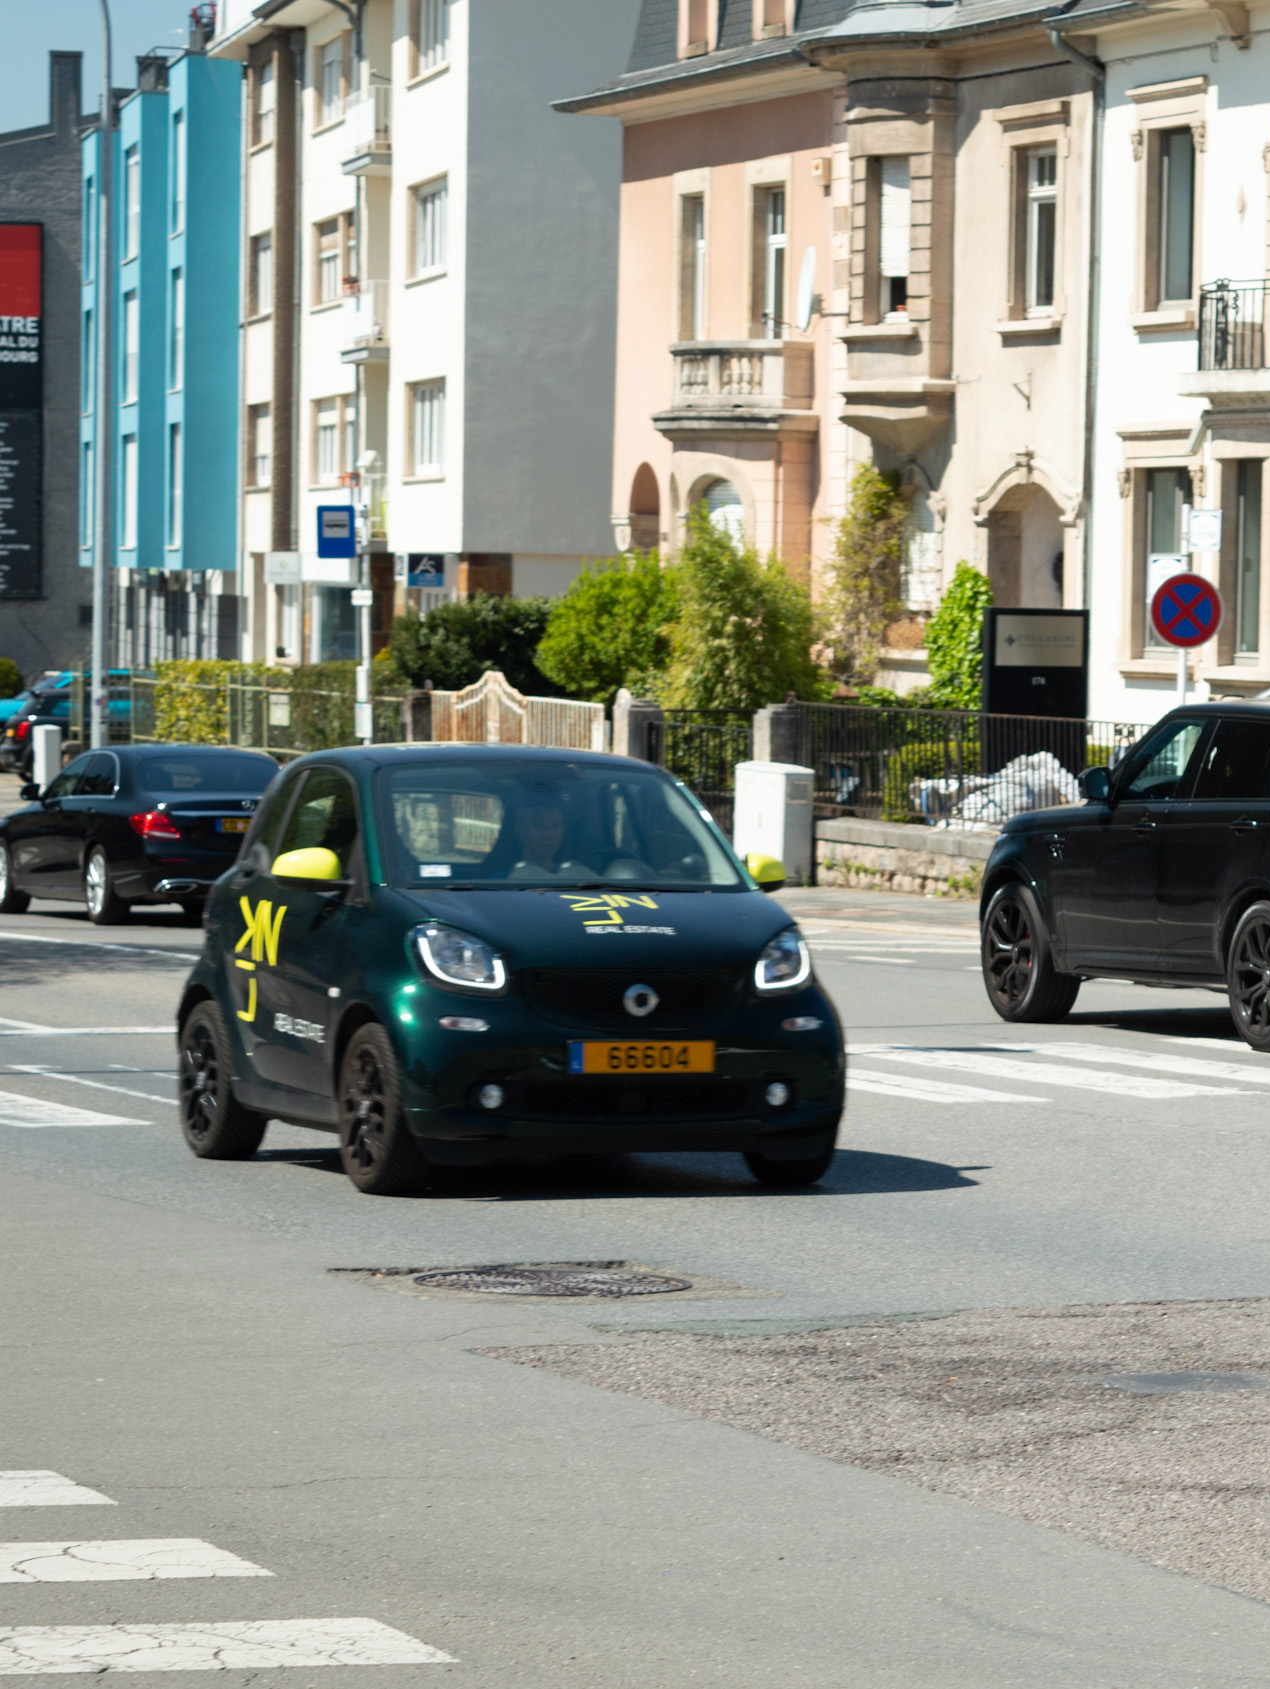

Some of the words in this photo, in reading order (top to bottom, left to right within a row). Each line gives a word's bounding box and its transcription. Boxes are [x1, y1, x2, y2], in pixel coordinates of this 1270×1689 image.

[0, 316, 39, 333] TRE
[623, 925, 677, 935] ESTATE
[608, 1046, 689, 1069] 66604
